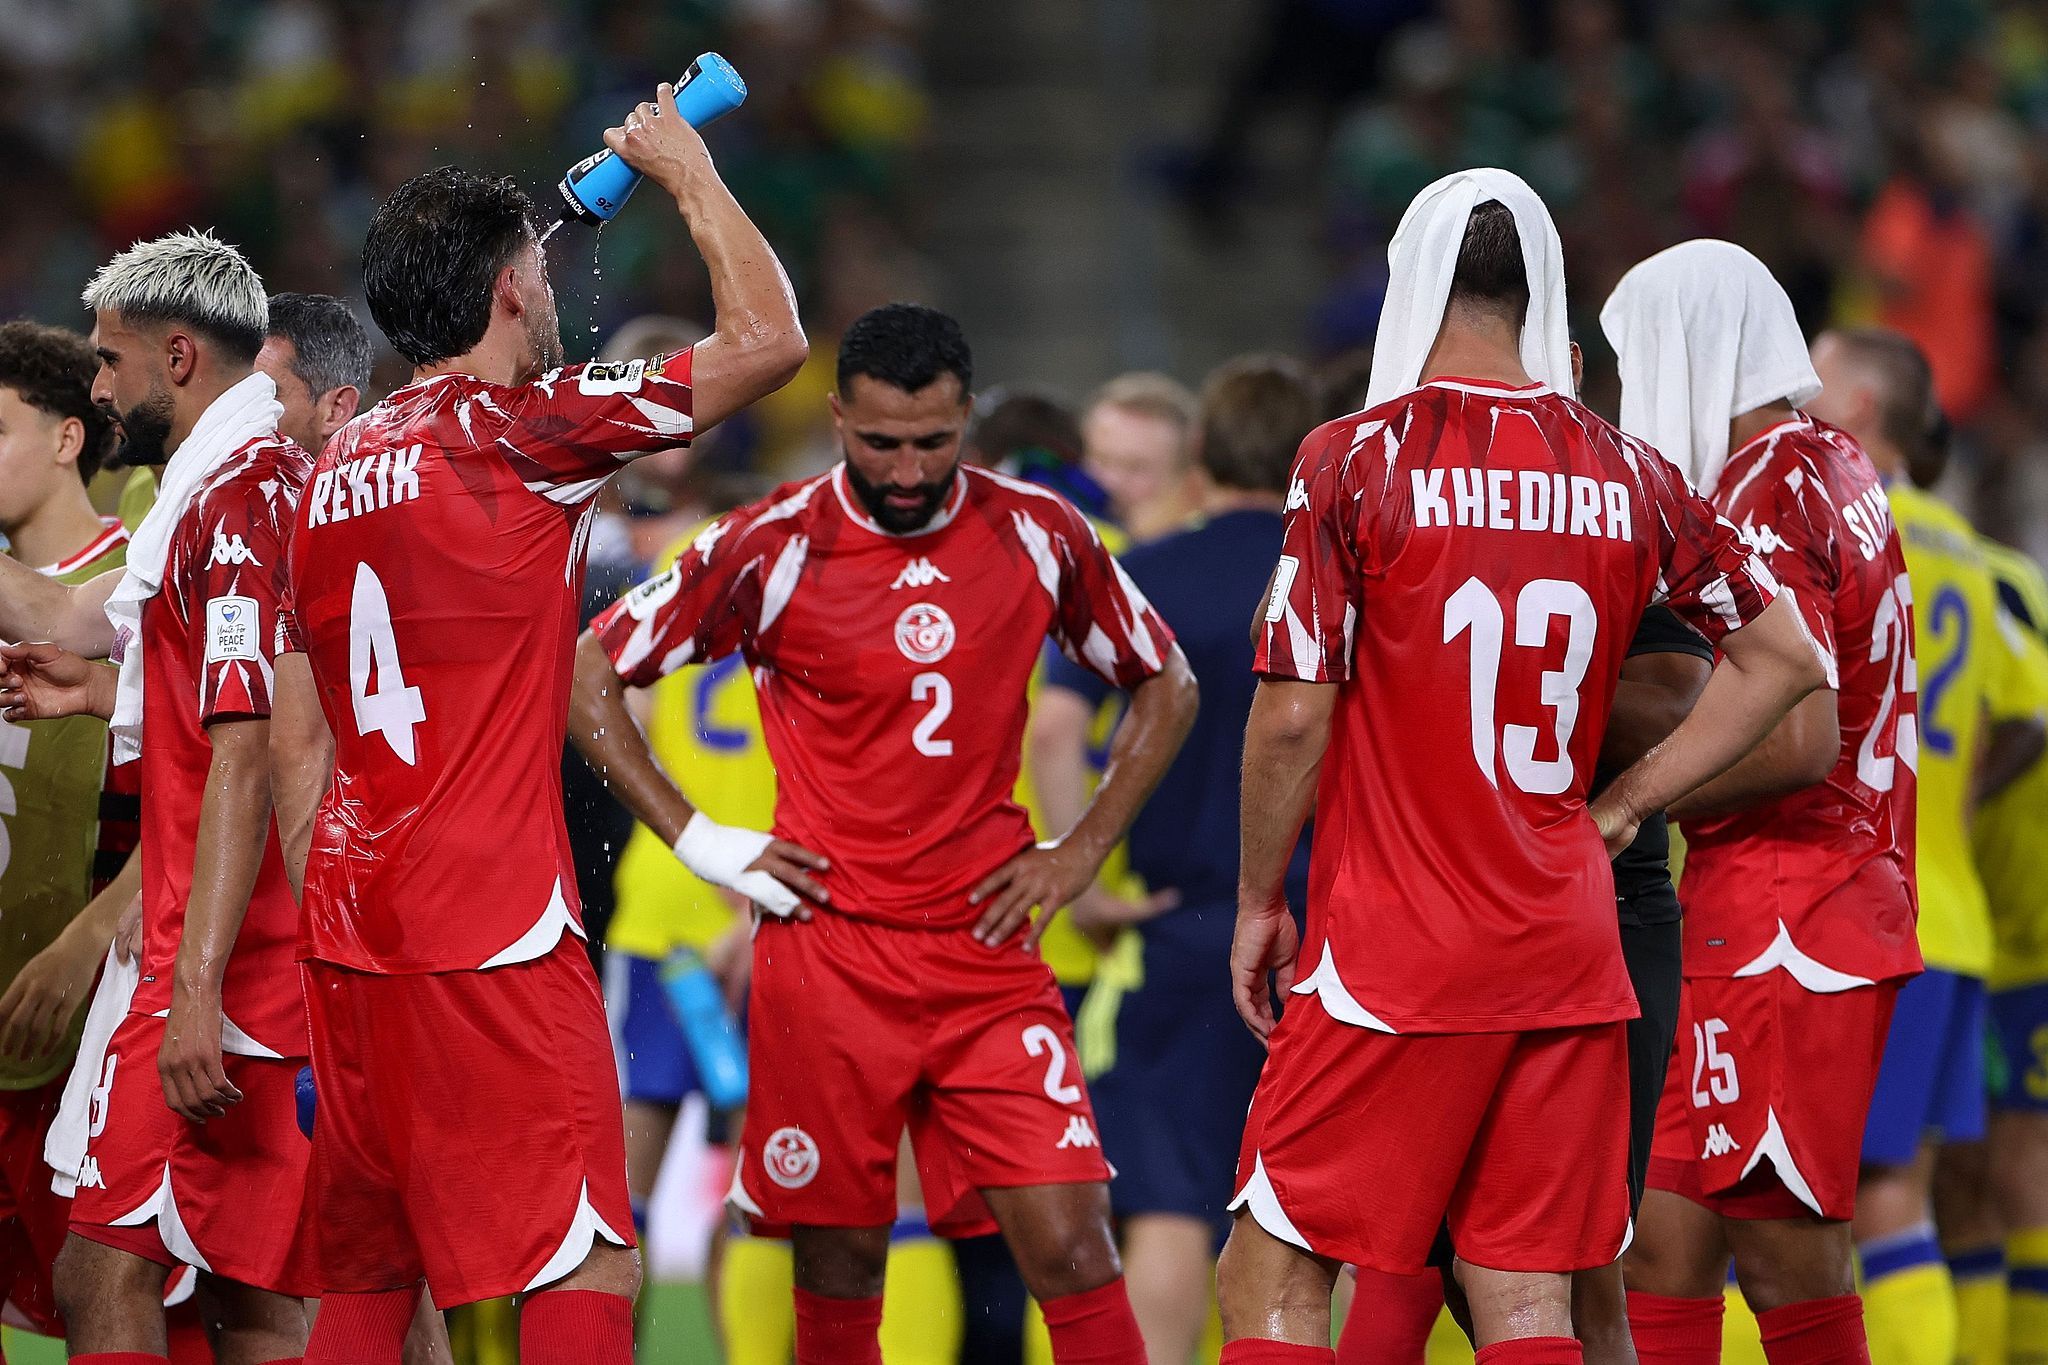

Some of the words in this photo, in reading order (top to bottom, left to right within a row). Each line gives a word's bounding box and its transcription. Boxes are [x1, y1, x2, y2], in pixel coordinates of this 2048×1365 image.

[595, 196, 614, 212] 26
[307, 443, 423, 529] REKIK
[1410, 467, 1633, 542] KHEDIRA
[218, 634, 245, 647] PEACE
[349, 560, 427, 766] 4
[911, 671, 954, 758] 2
[1443, 575, 1598, 795] 13
[1021, 1023, 1082, 1105] 2
[1692, 1017, 1740, 1109] 25
